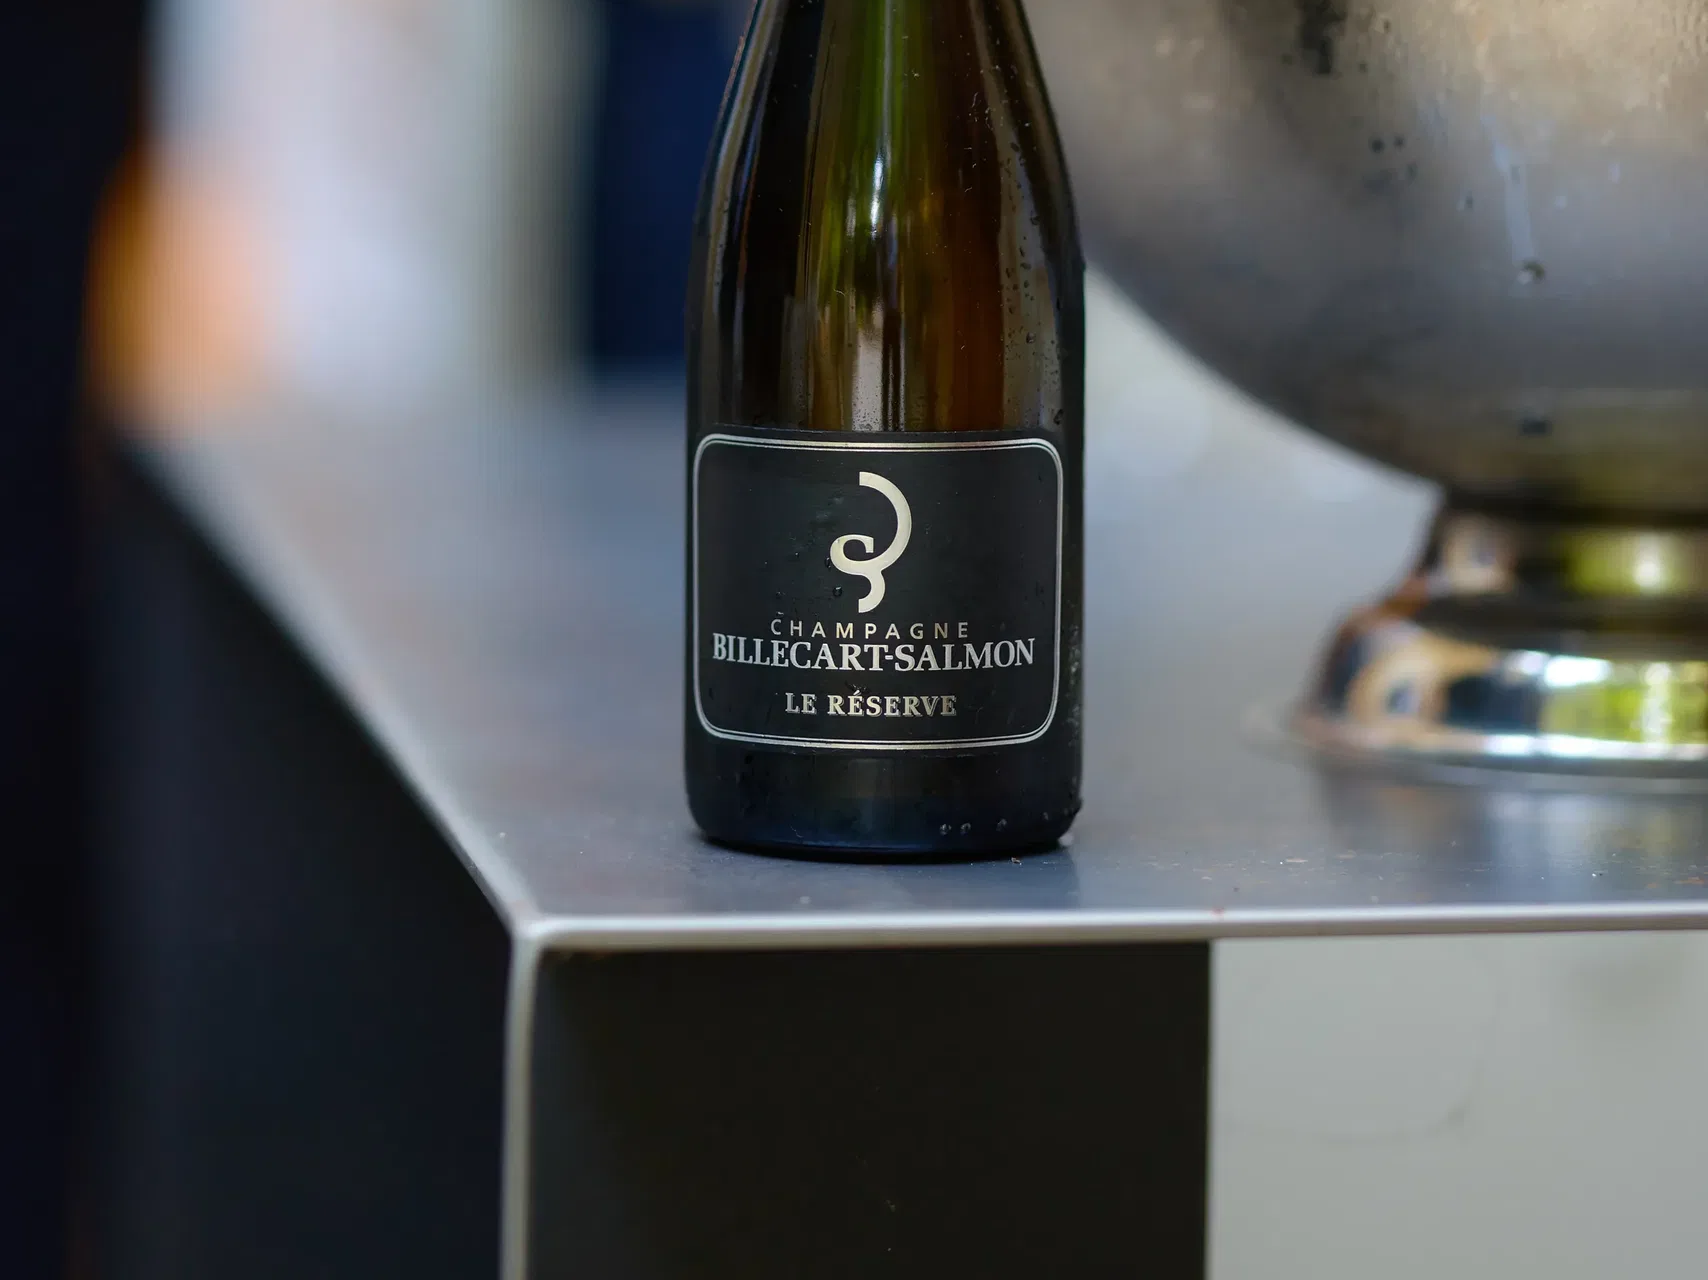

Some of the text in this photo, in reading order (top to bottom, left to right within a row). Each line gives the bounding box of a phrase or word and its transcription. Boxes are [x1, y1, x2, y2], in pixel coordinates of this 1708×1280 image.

[770, 619, 969, 640] CHAMPAGNE
[712, 632, 1036, 672] BILLECART-SALMON
[785, 689, 957, 717] LE RÉSERVE
